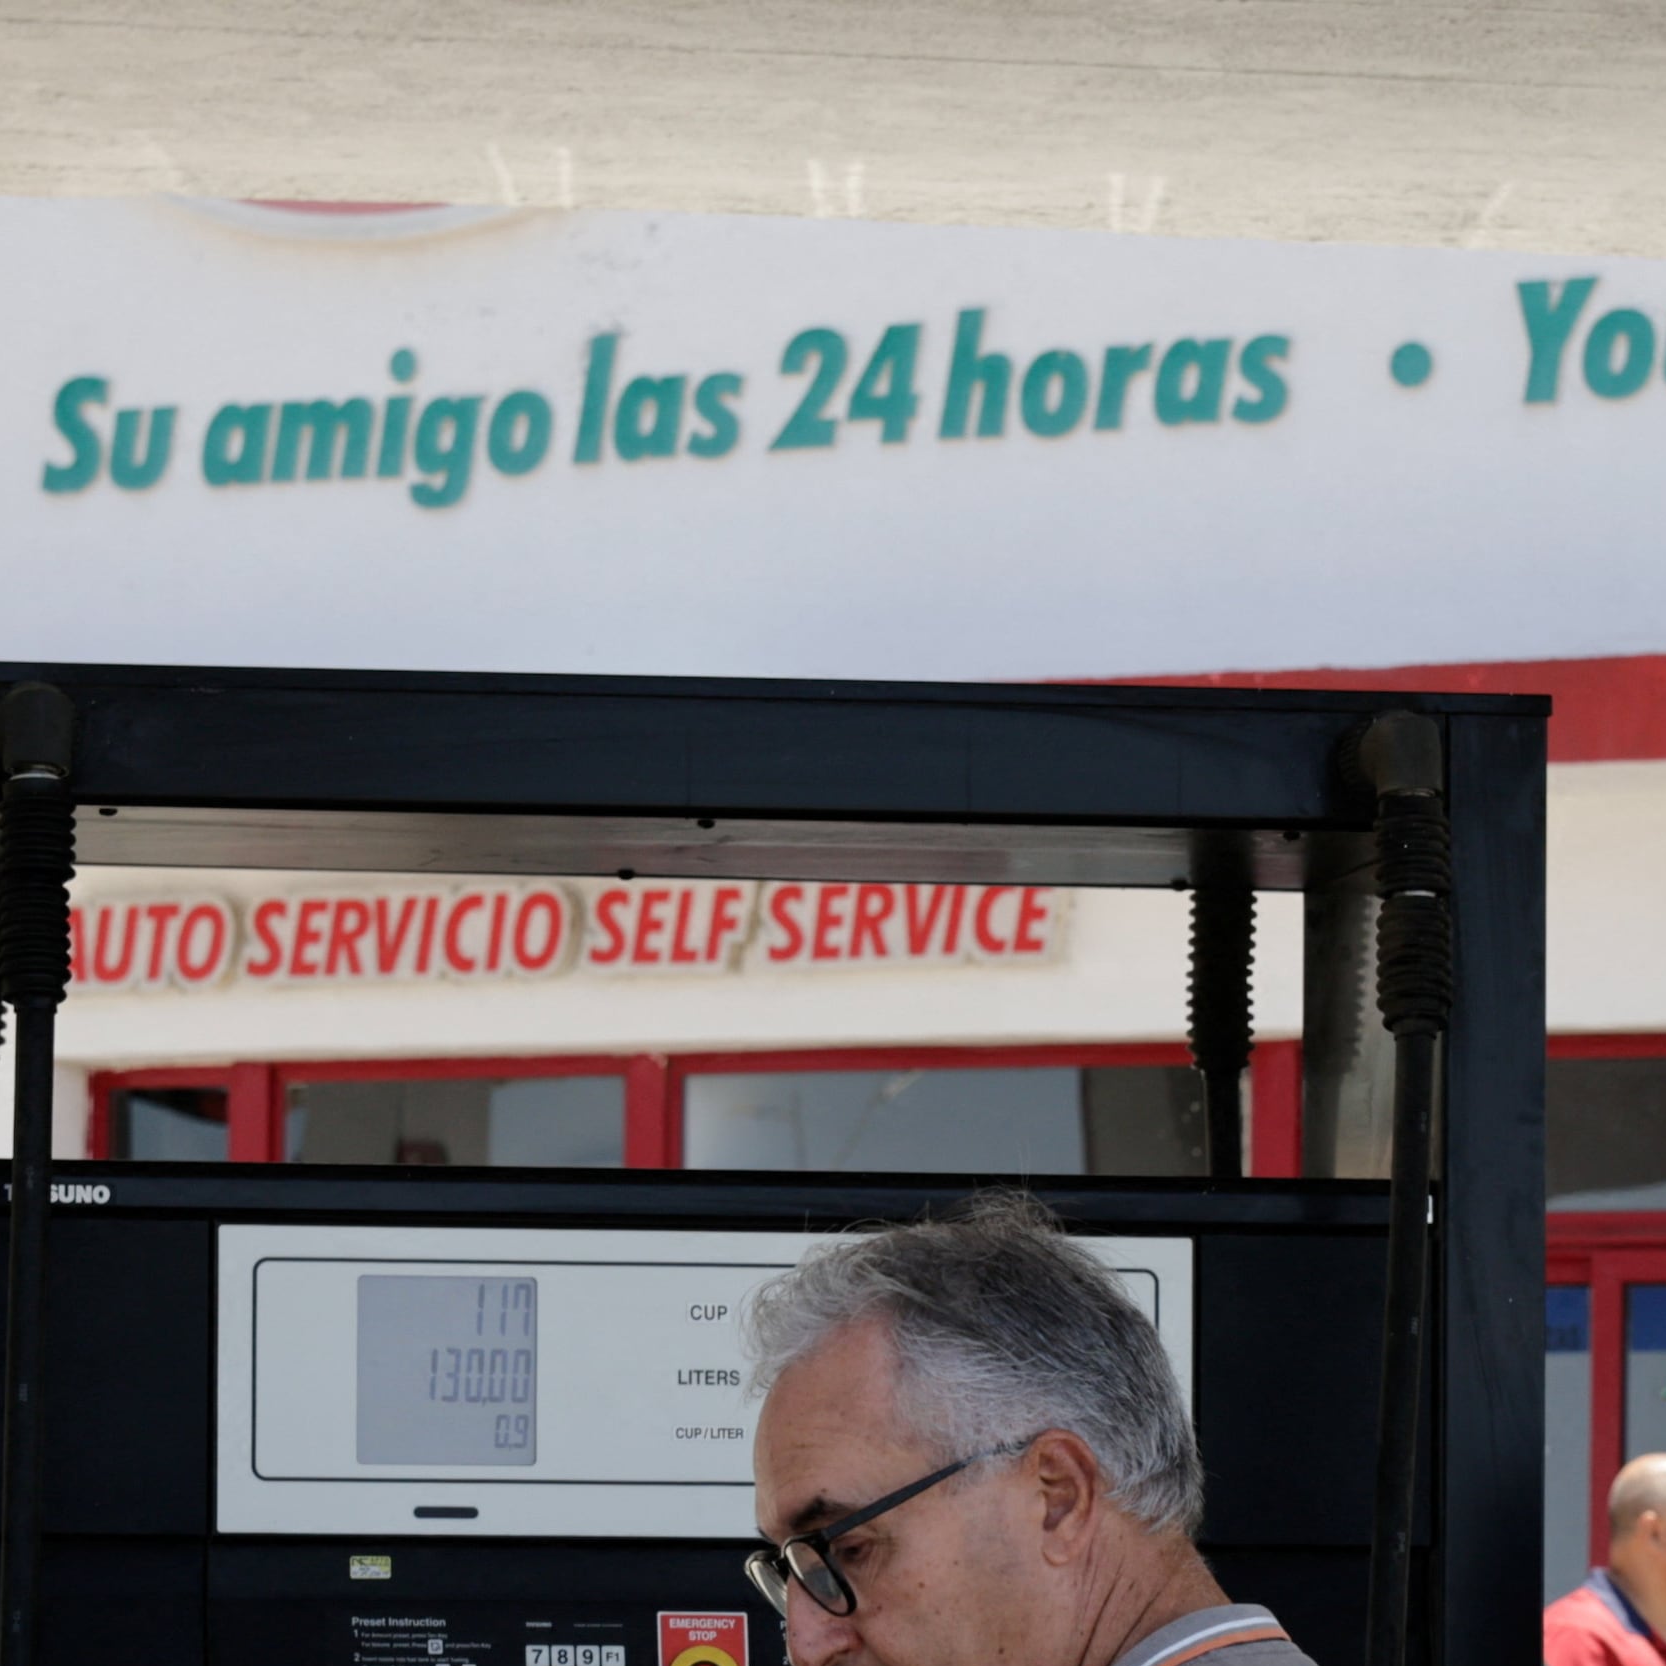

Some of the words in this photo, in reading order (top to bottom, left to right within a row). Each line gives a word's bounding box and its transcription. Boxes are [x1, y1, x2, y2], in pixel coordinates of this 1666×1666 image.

[42, 376, 174, 493] Su
[202, 349, 552, 508] amigo
[573, 332, 743, 464] las
[767, 322, 924, 452] 24
[941, 308, 1291, 440] horas
[589, 887, 742, 963] SELF
[767, 884, 1052, 960] SERVICE
[70, 903, 226, 983] AUTO
[246, 891, 563, 977] SERVICIO
[3, 1183, 111, 1204] TSUNO
[476, 1283, 530, 1337] 117
[690, 1304, 728, 1321] CUP
[677, 1369, 741, 1386] LITERS
[351, 1616, 386, 1627] Preset
[388, 1616, 447, 1627] Instruction
[669, 1618, 736, 1629] EMERGENCY
[688, 1630, 717, 1641] STOP
[532, 1649, 543, 1664] 7
[557, 1649, 568, 1664] 8
[582, 1649, 593, 1664] 9
[606, 1652, 620, 1662] F1
